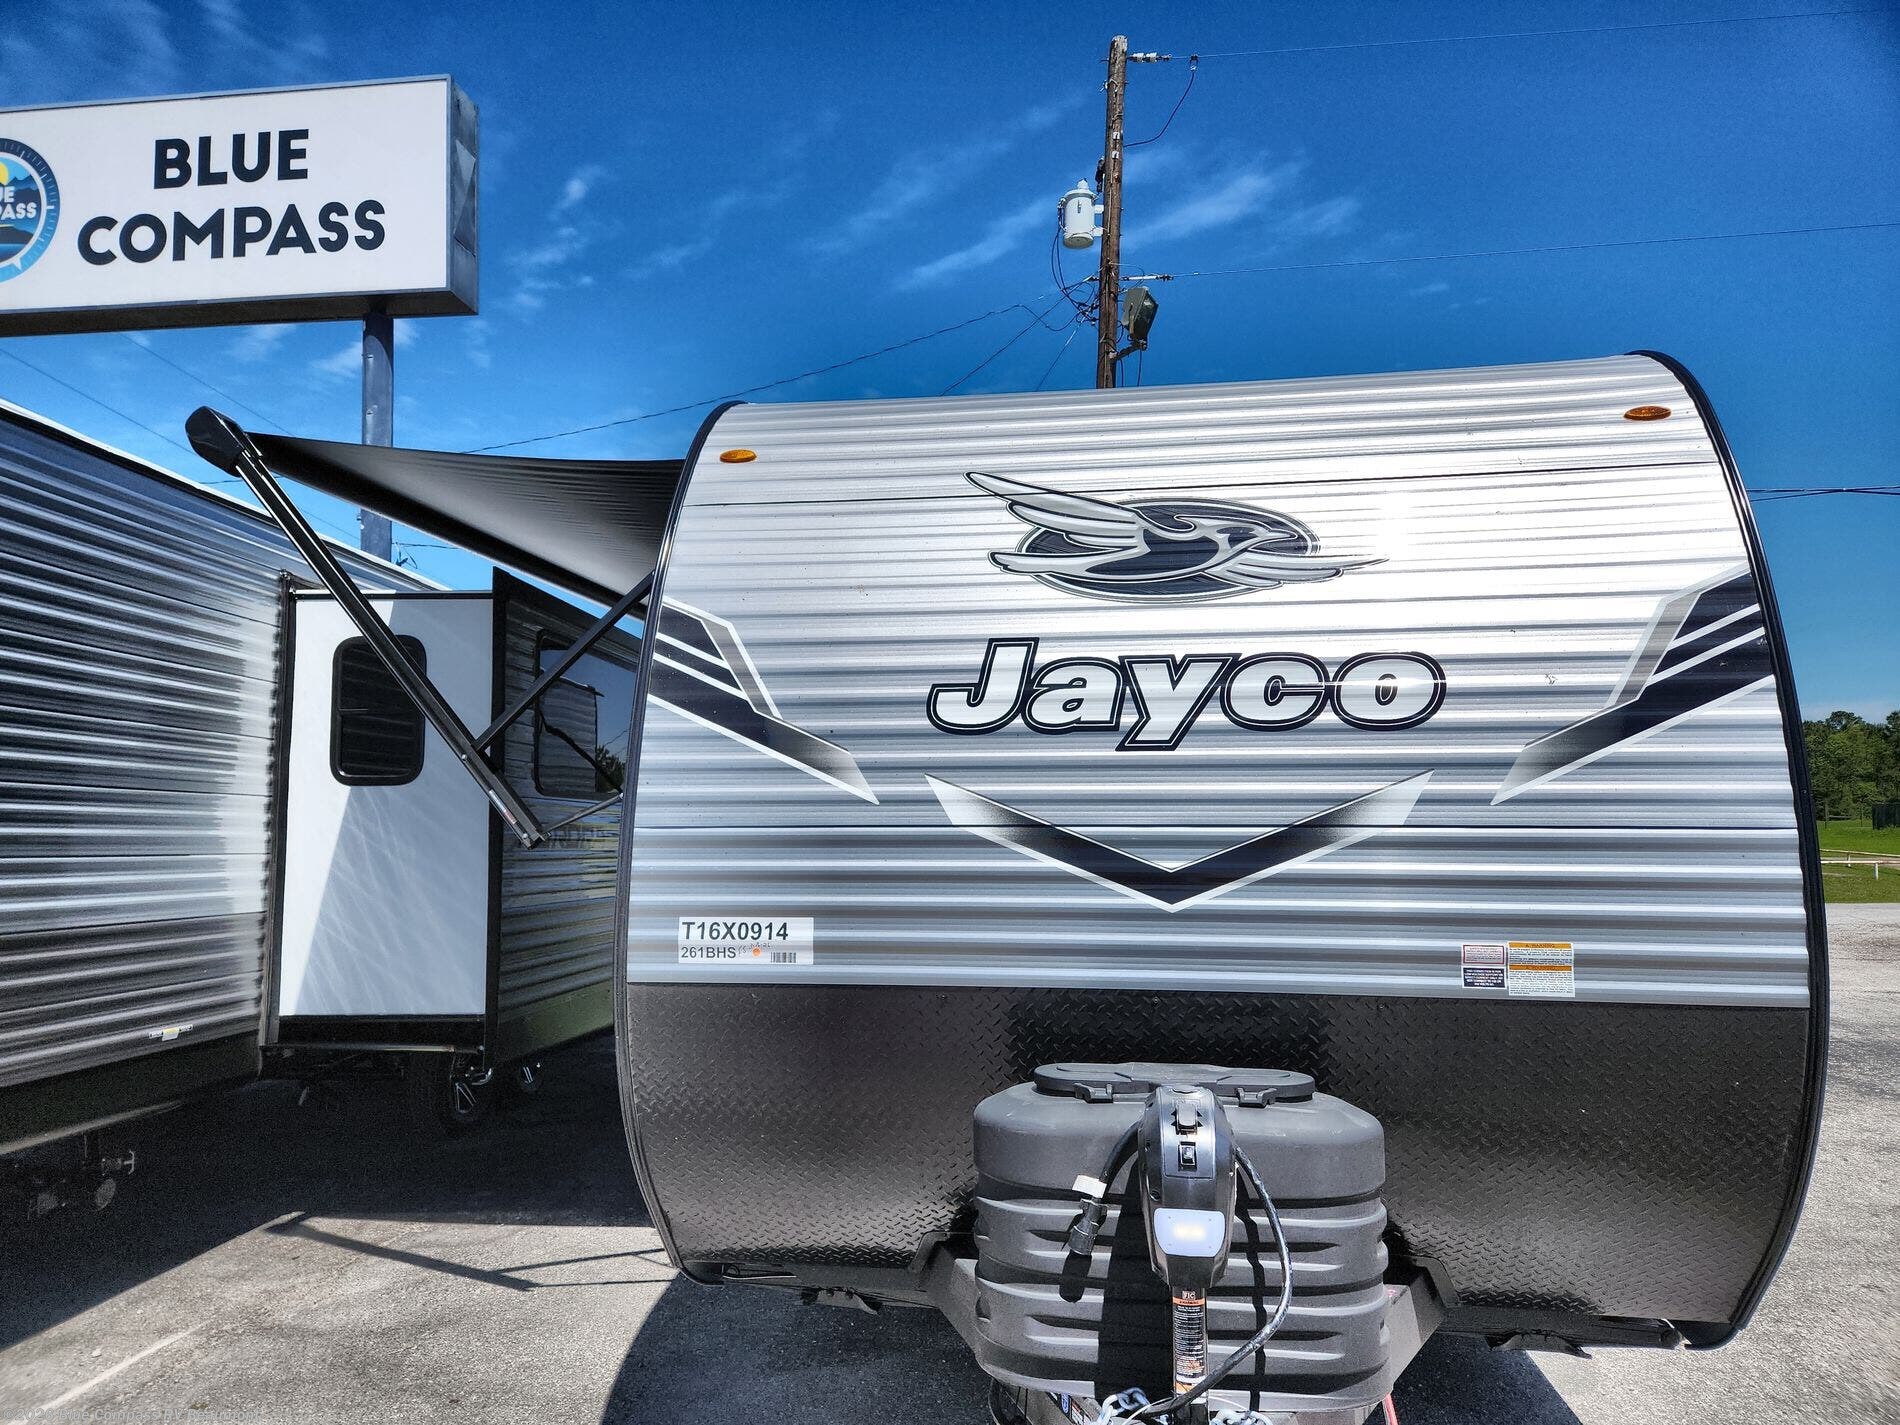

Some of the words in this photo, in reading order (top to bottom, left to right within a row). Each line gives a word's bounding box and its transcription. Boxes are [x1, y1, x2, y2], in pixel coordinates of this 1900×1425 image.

[153, 128, 310, 190] BLUE
[77, 199, 386, 266] COMPASS
[926, 637, 1447, 751] Jayco
[681, 921, 789, 941] T16X0914
[681, 946, 737, 959] 261BHS
